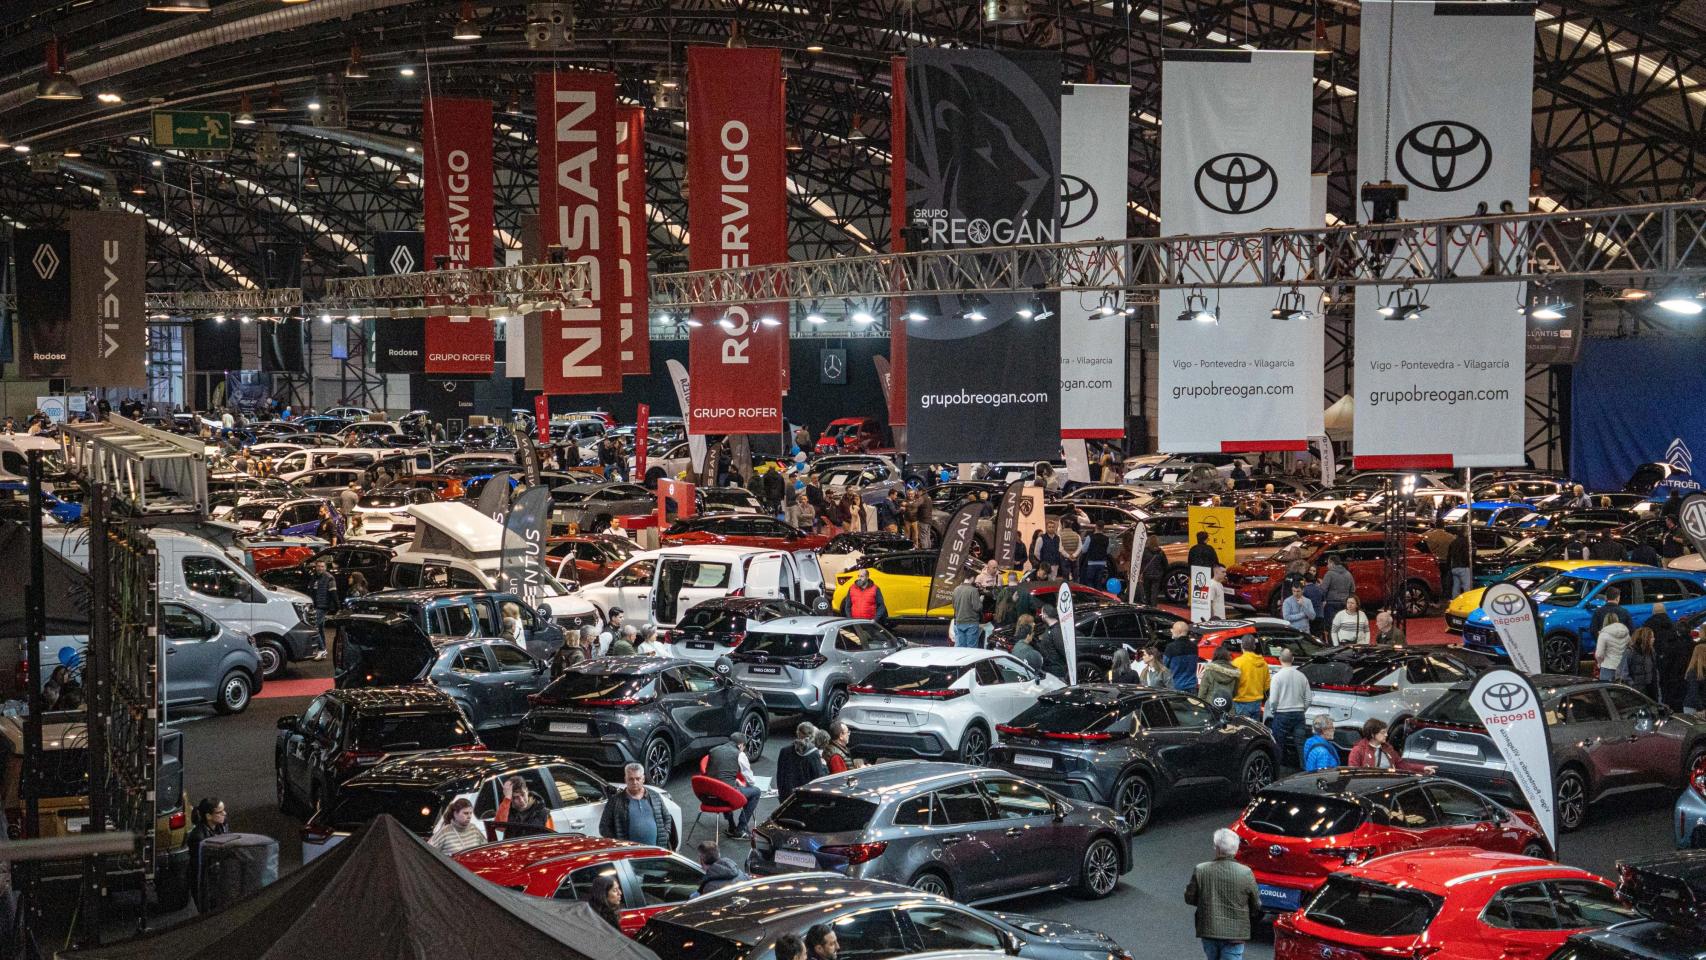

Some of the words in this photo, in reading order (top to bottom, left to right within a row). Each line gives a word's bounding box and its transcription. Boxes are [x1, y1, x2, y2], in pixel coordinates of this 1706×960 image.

[914, 208, 948, 218] GRUPO
[722, 120, 749, 364] ROERVIGO
[33, 352, 66, 360] Rodosa
[428, 353, 460, 361] GRUPO
[462, 353, 491, 361] ROFER
[1173, 360, 1192, 369] Vigo
[1200, 359, 1247, 368] Pontevedra
[1370, 360, 1392, 370] Vigo
[1401, 359, 1454, 369] Pontevedra
[1173, 381, 1294, 399] grupobreogan.com
[1370, 385, 1509, 405] grupobreogan.com
[921, 389, 1048, 408] grupobreogan.com
[693, 407, 736, 419] GRUPO
[738, 407, 777, 418] ROFER
[1003, 492, 1016, 560] NISSAN
[944, 512, 972, 585] NISSAN
[1260, 889, 1287, 898] COROLLA
